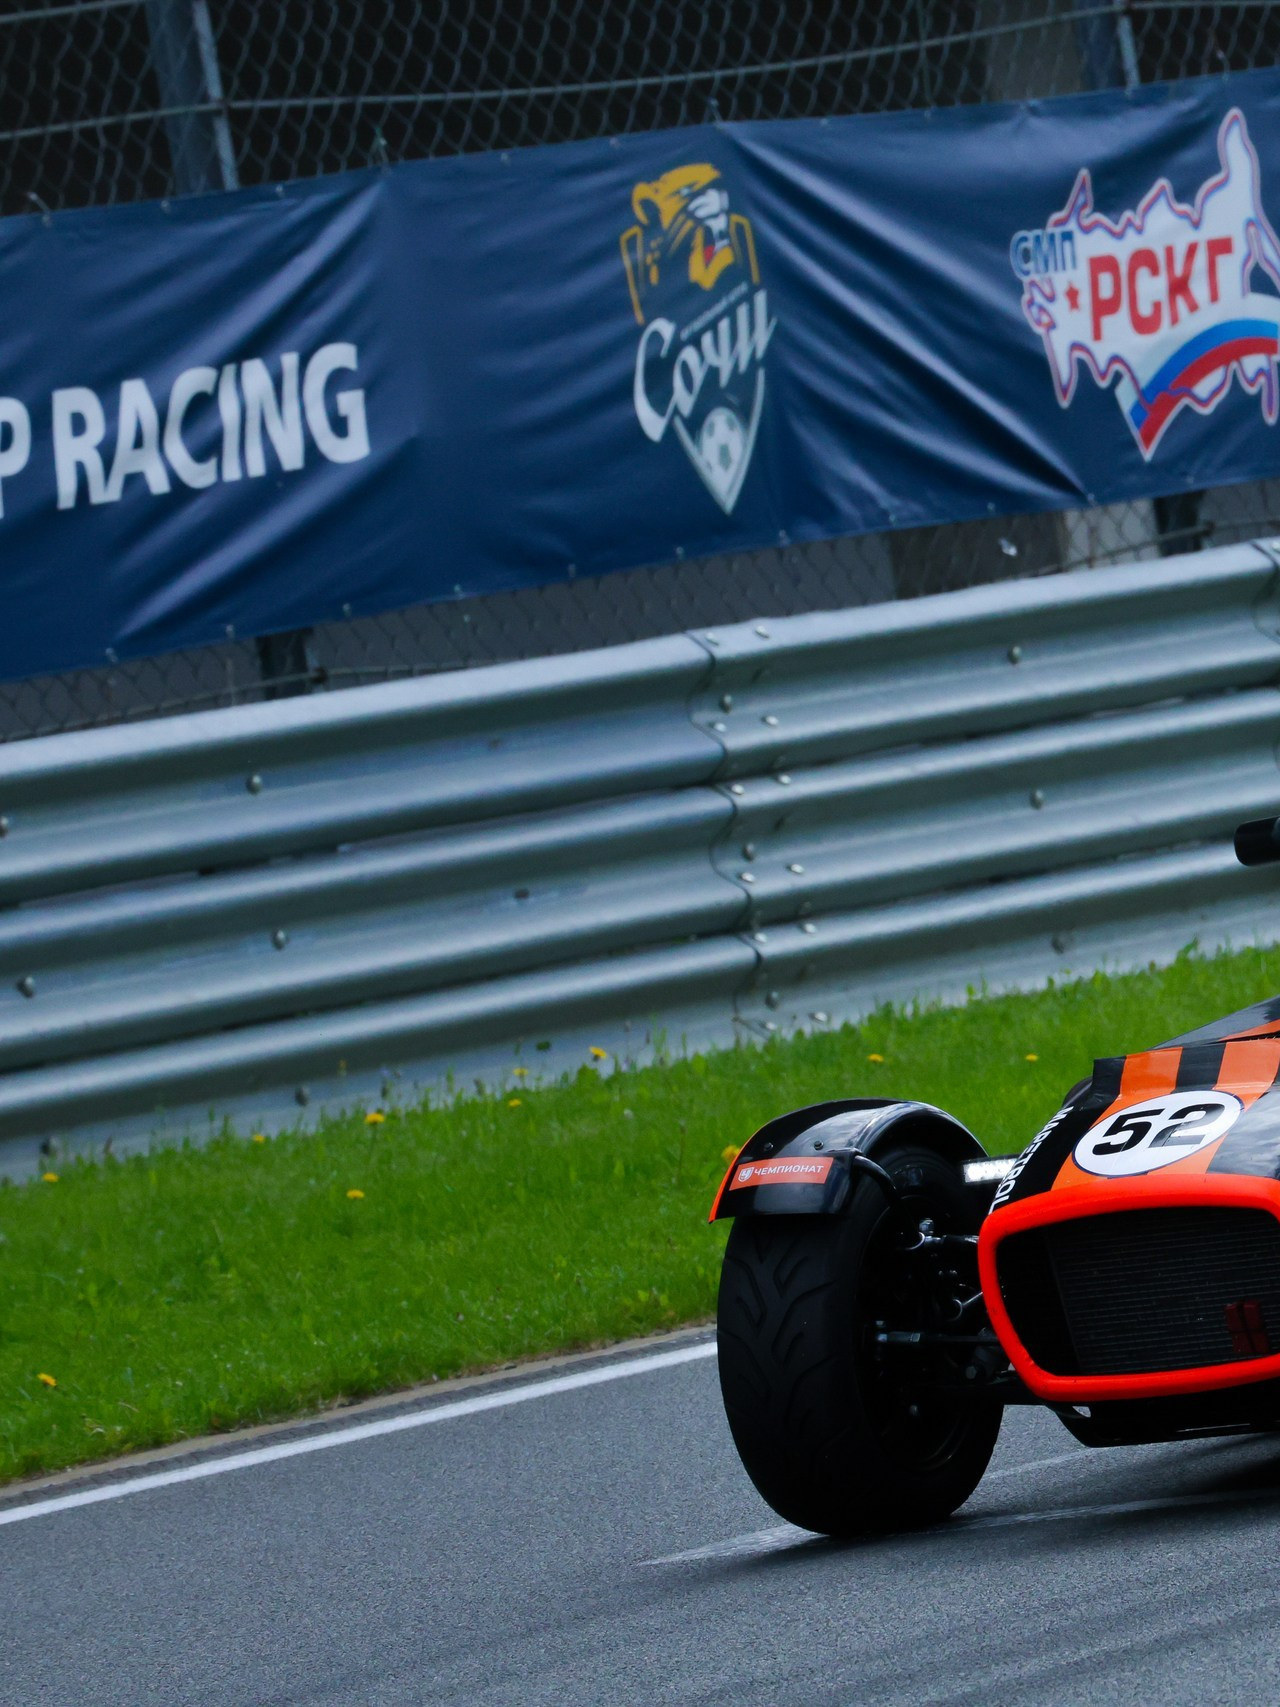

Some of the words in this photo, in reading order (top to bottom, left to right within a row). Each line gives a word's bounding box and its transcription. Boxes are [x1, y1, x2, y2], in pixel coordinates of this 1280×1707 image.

[1010, 229, 1078, 281] СМП
[1088, 237, 1234, 342] РСКГ
[51, 342, 371, 510] RACING
[1091, 1103, 1226, 1156] 52
[754, 1165, 824, 1176] ЧЕМПИОНАТ
